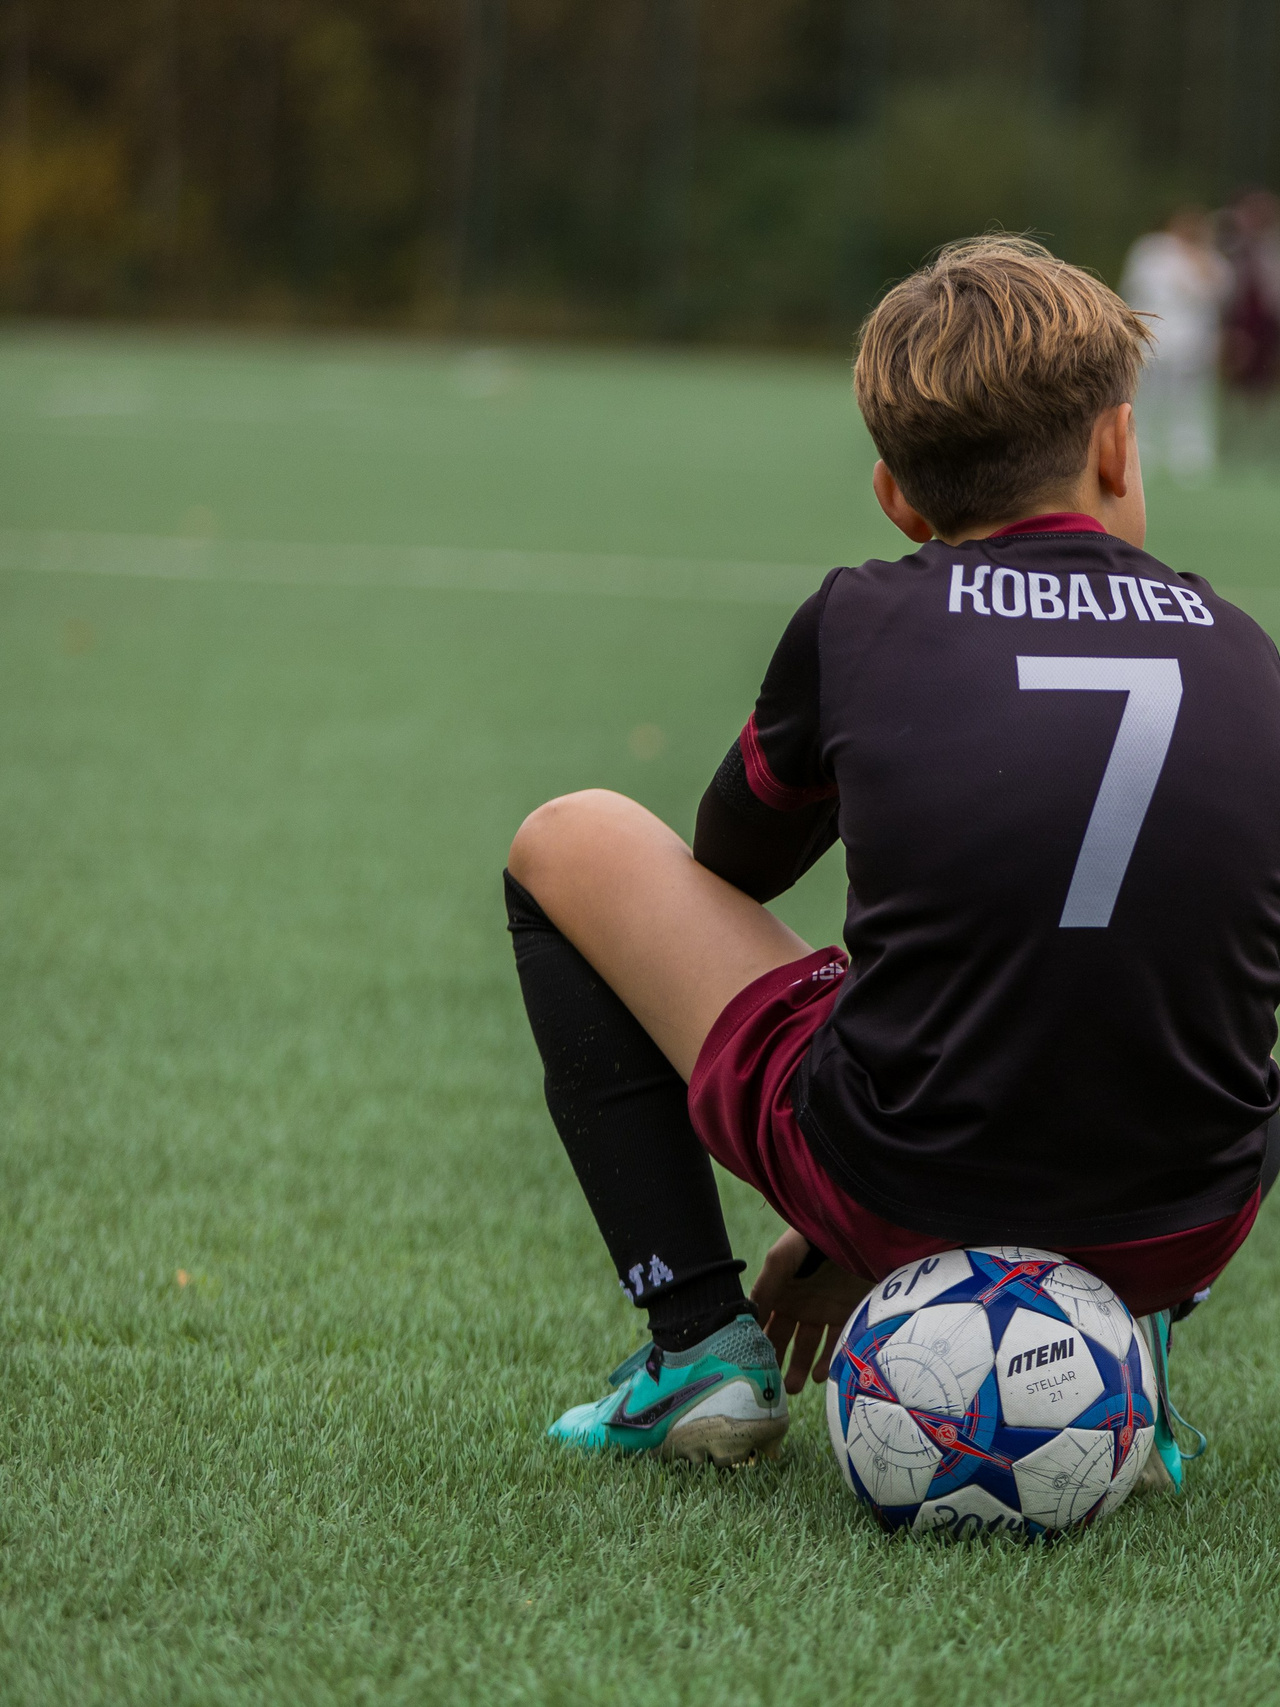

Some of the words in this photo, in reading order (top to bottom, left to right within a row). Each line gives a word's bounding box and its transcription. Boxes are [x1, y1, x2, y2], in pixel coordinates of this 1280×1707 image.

[948, 564, 1215, 626] КОВАЛЕВ
[1016, 655, 1183, 928] 7
[1007, 1337, 1074, 1377] ATEMI
[1026, 1370, 1077, 1394] STELLAR
